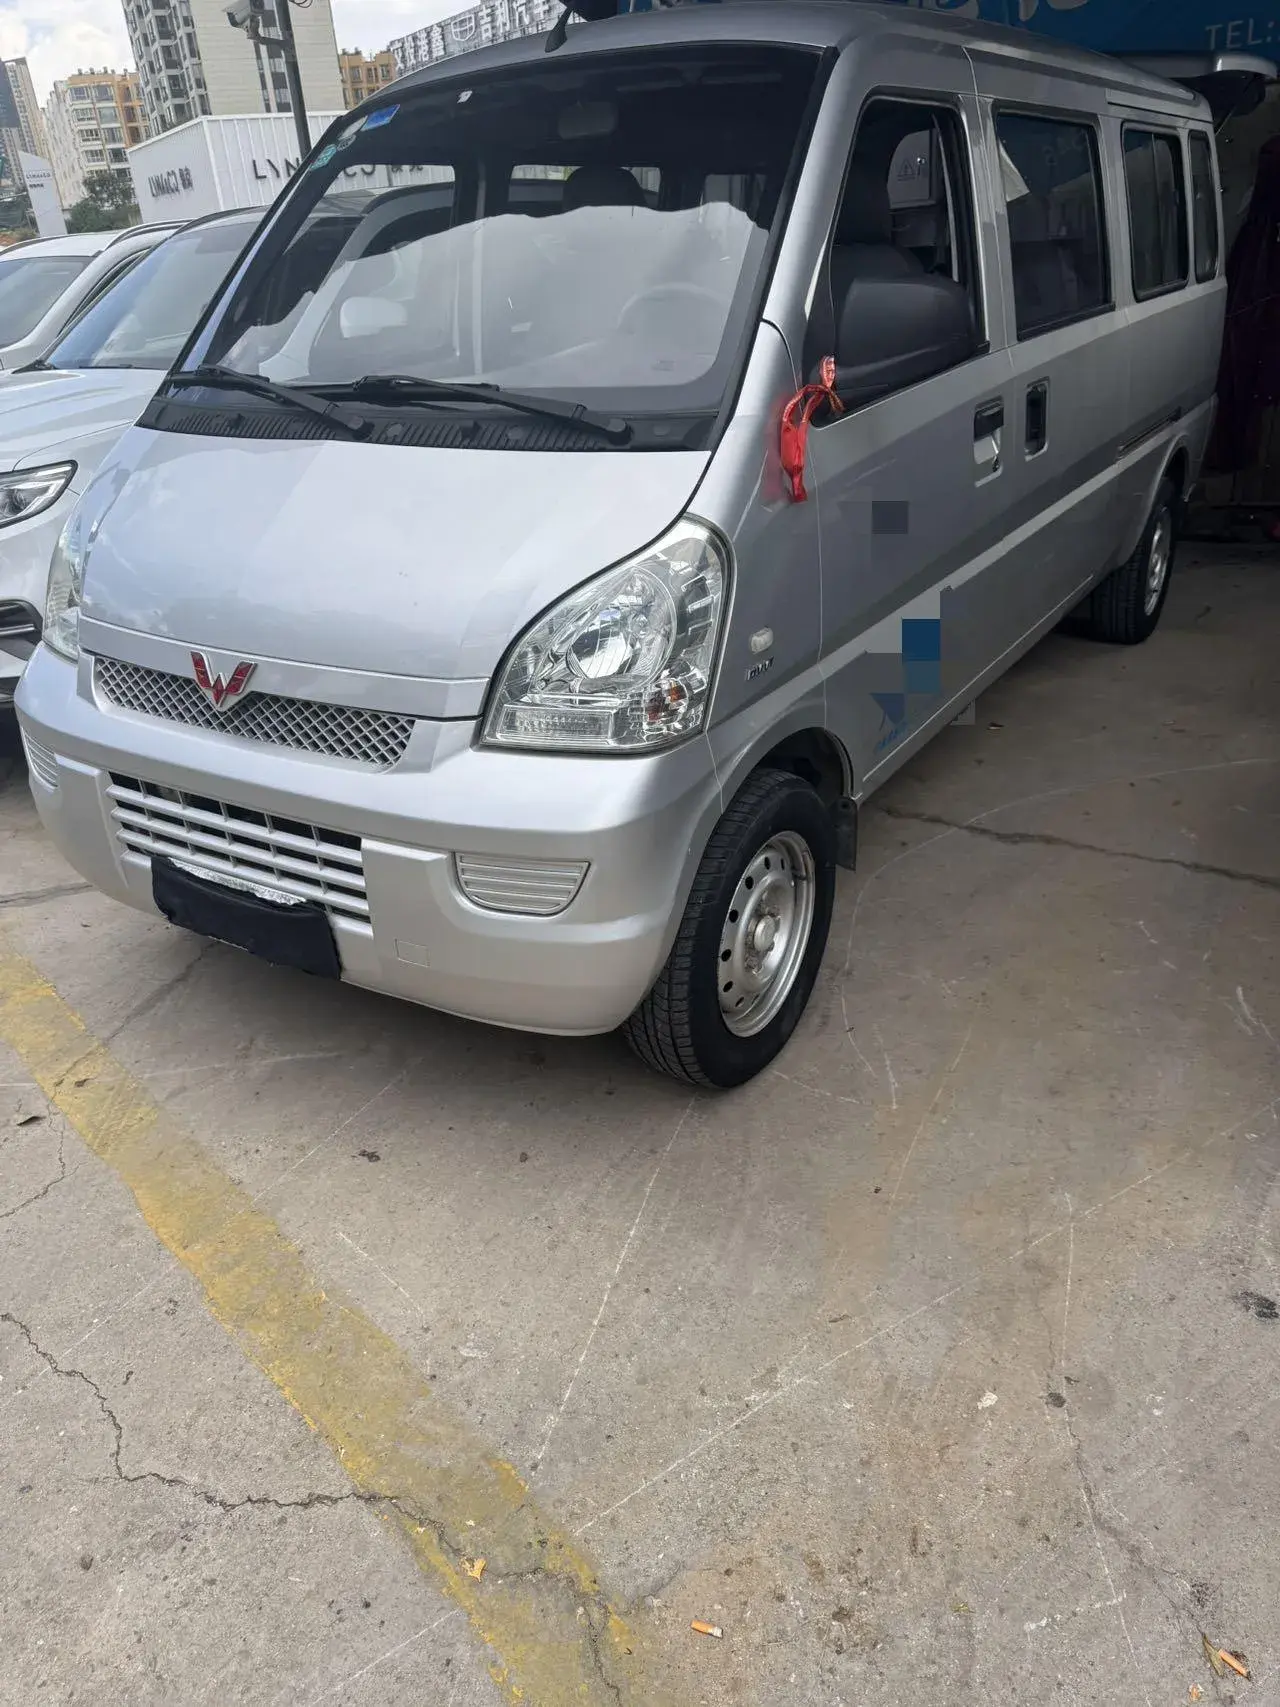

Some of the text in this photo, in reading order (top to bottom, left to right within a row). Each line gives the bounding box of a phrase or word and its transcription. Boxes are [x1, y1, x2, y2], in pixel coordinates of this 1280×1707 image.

[478, 0, 549, 40] 吉利汽车
[1204, 18, 1275, 51] TEL:
